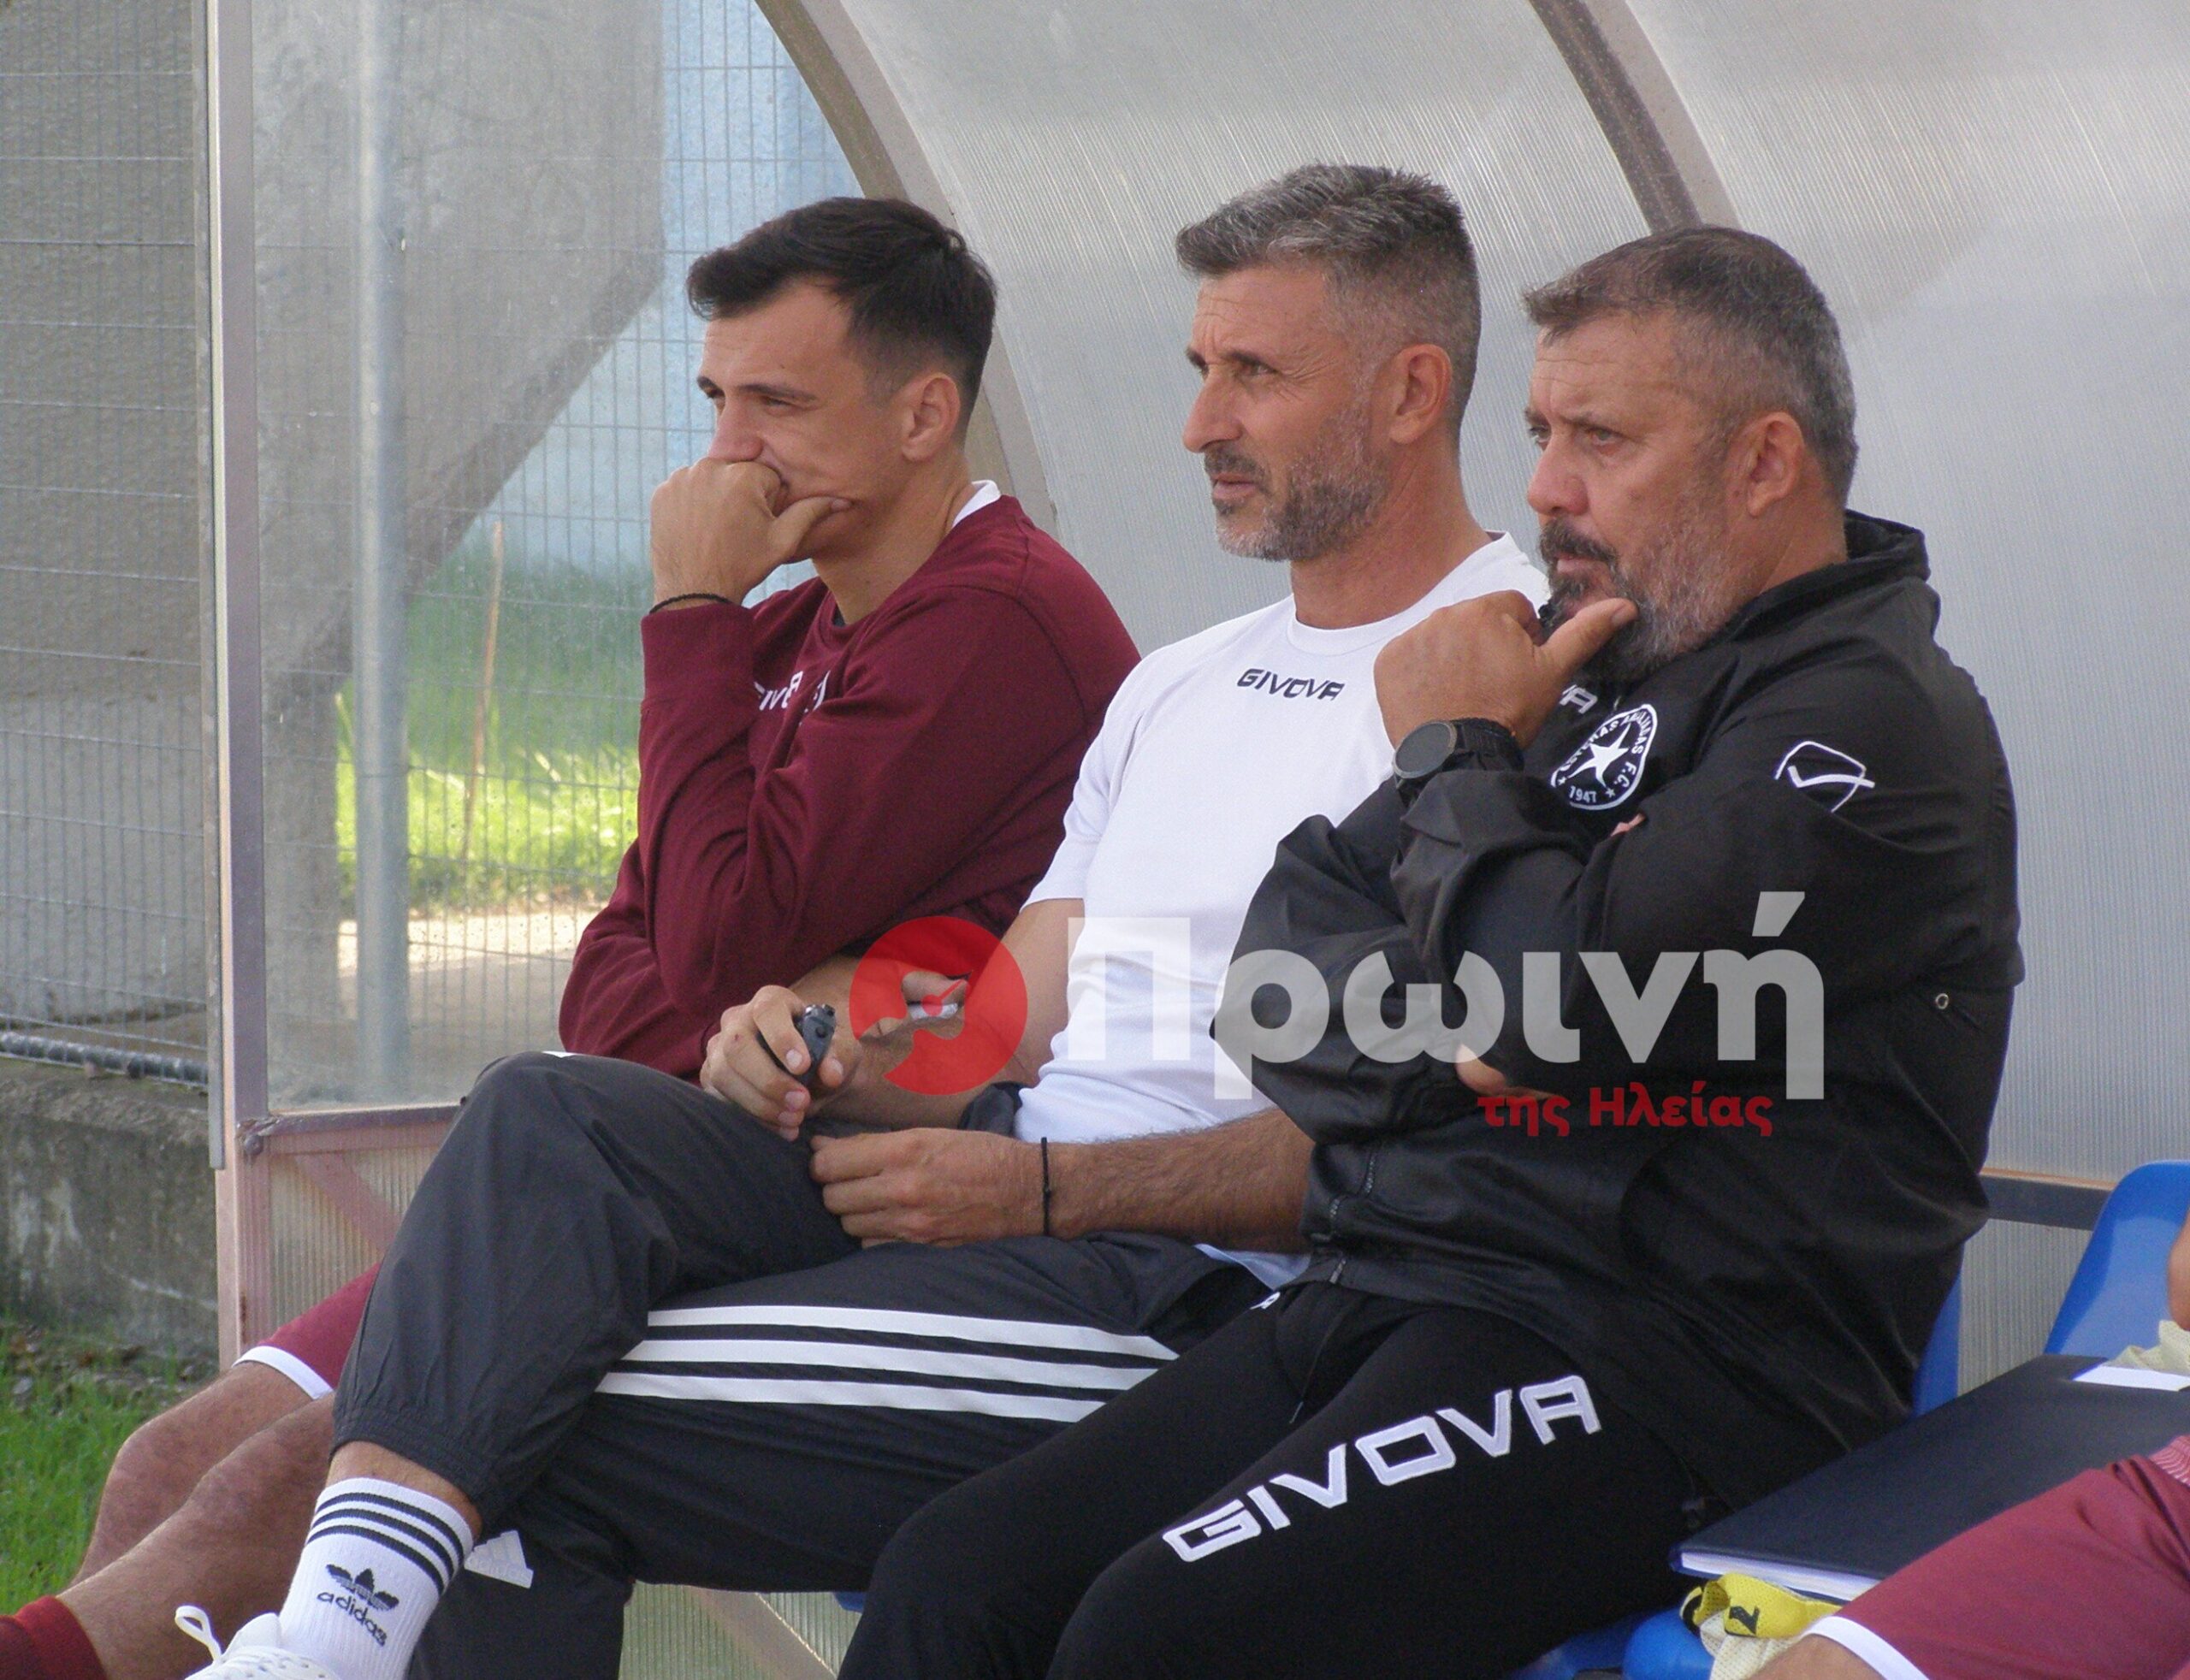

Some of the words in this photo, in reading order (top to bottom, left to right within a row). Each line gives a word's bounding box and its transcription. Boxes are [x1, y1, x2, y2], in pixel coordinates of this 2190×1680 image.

[1237, 668, 1346, 701] GIVOVA
[1613, 761, 1637, 788] F.C.
[1568, 785, 1598, 803] 1947
[1162, 1374, 1602, 1563] GIVOVA
[317, 1592, 388, 1647] adidas
